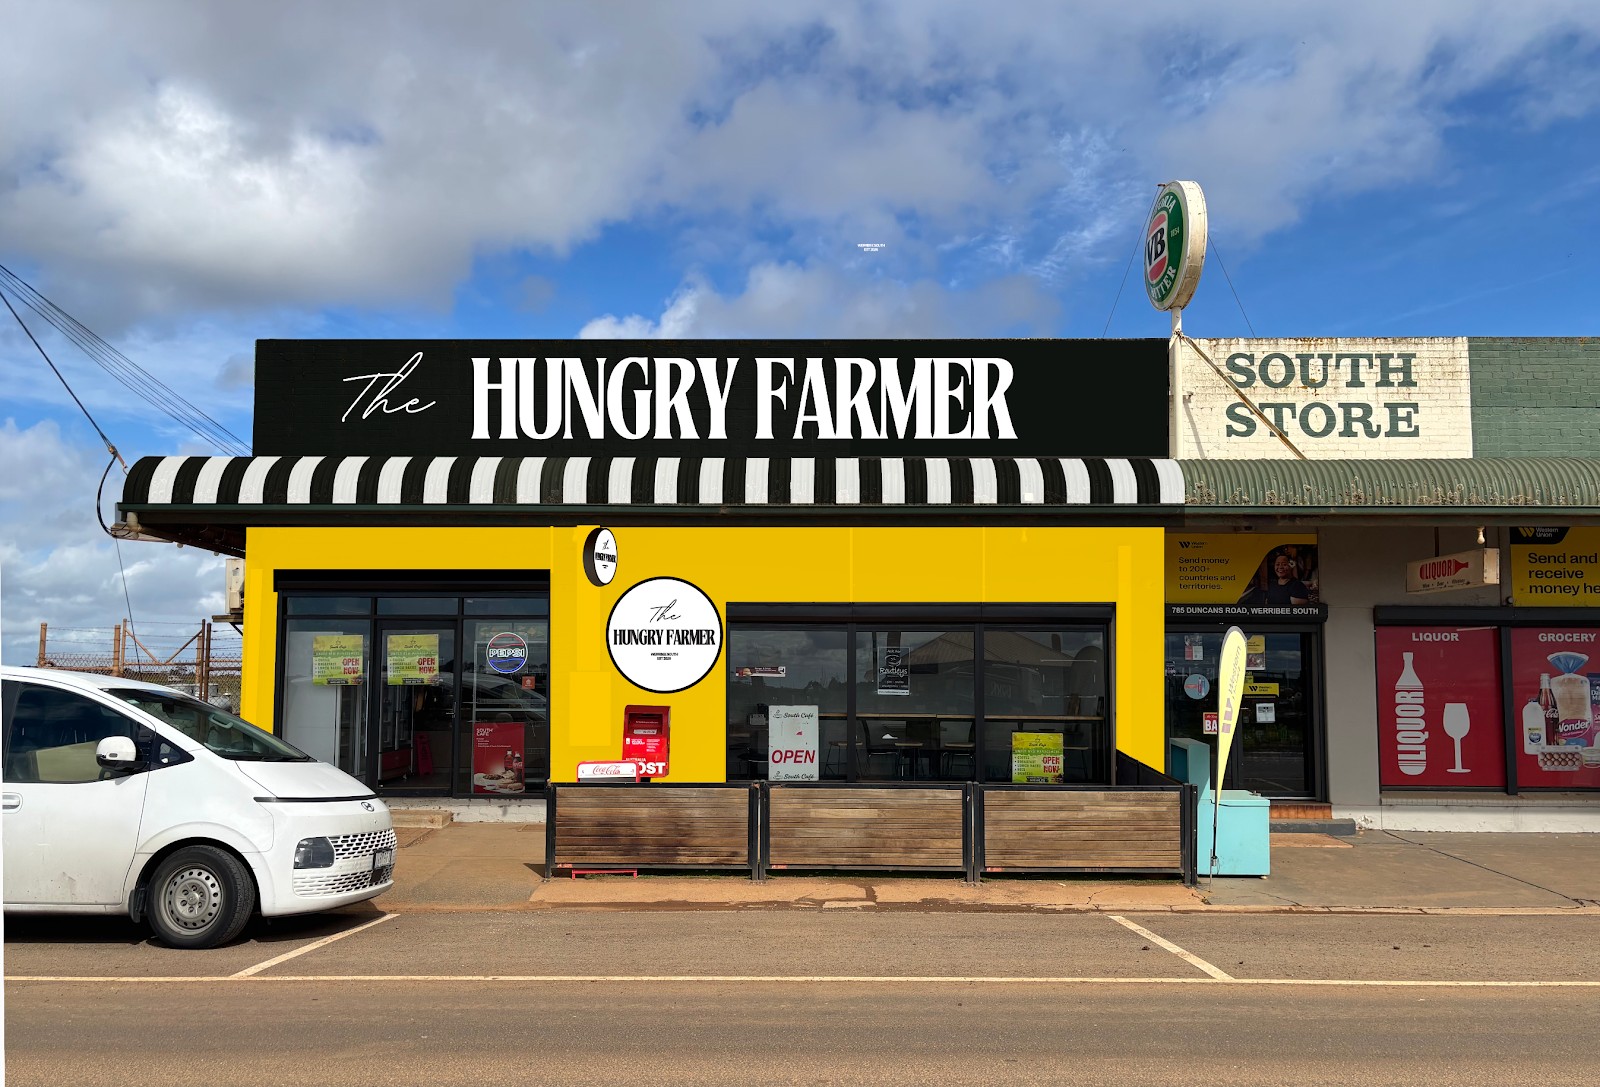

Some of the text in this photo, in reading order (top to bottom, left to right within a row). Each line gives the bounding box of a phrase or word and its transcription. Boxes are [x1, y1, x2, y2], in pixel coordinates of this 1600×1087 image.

[1147, 227, 1166, 266] VB
[1225, 353, 1418, 388] SOUTH
[342, 352, 1018, 440] The HUNGRY FARMER
[1225, 402, 1420, 438] STORE
[1178, 556, 1230, 566] Send money
[1528, 552, 1598, 564] Send and
[1425, 559, 1452, 580] LIQUOR
[1528, 567, 1584, 579] receive
[1179, 573, 1236, 581] countries and
[1179, 582, 1223, 590] territories.
[1529, 584, 1581, 596] money
[650, 599, 681, 623] The
[1171, 606, 1185, 614] 785
[1225, 607, 1250, 616] ROAD,
[1250, 607, 1291, 615] WERRIBEE
[1292, 607, 1319, 615] SOUTH
[613, 629, 716, 645] HUNGRY FARMER
[1411, 632, 1460, 642] LIQUOR
[1538, 633, 1596, 643] GROCERY
[489, 648, 525, 658] PEPSI
[342, 658, 359, 666] OPEN
[417, 657, 435, 665] OPEN
[418, 666, 436, 674] NOW
[1395, 691, 1429, 761] LIQUOR
[771, 749, 816, 764] OPEN
[1042, 756, 1060, 764] OPEN
[638, 761, 666, 775] OST
[1043, 765, 1060, 773] NOW
